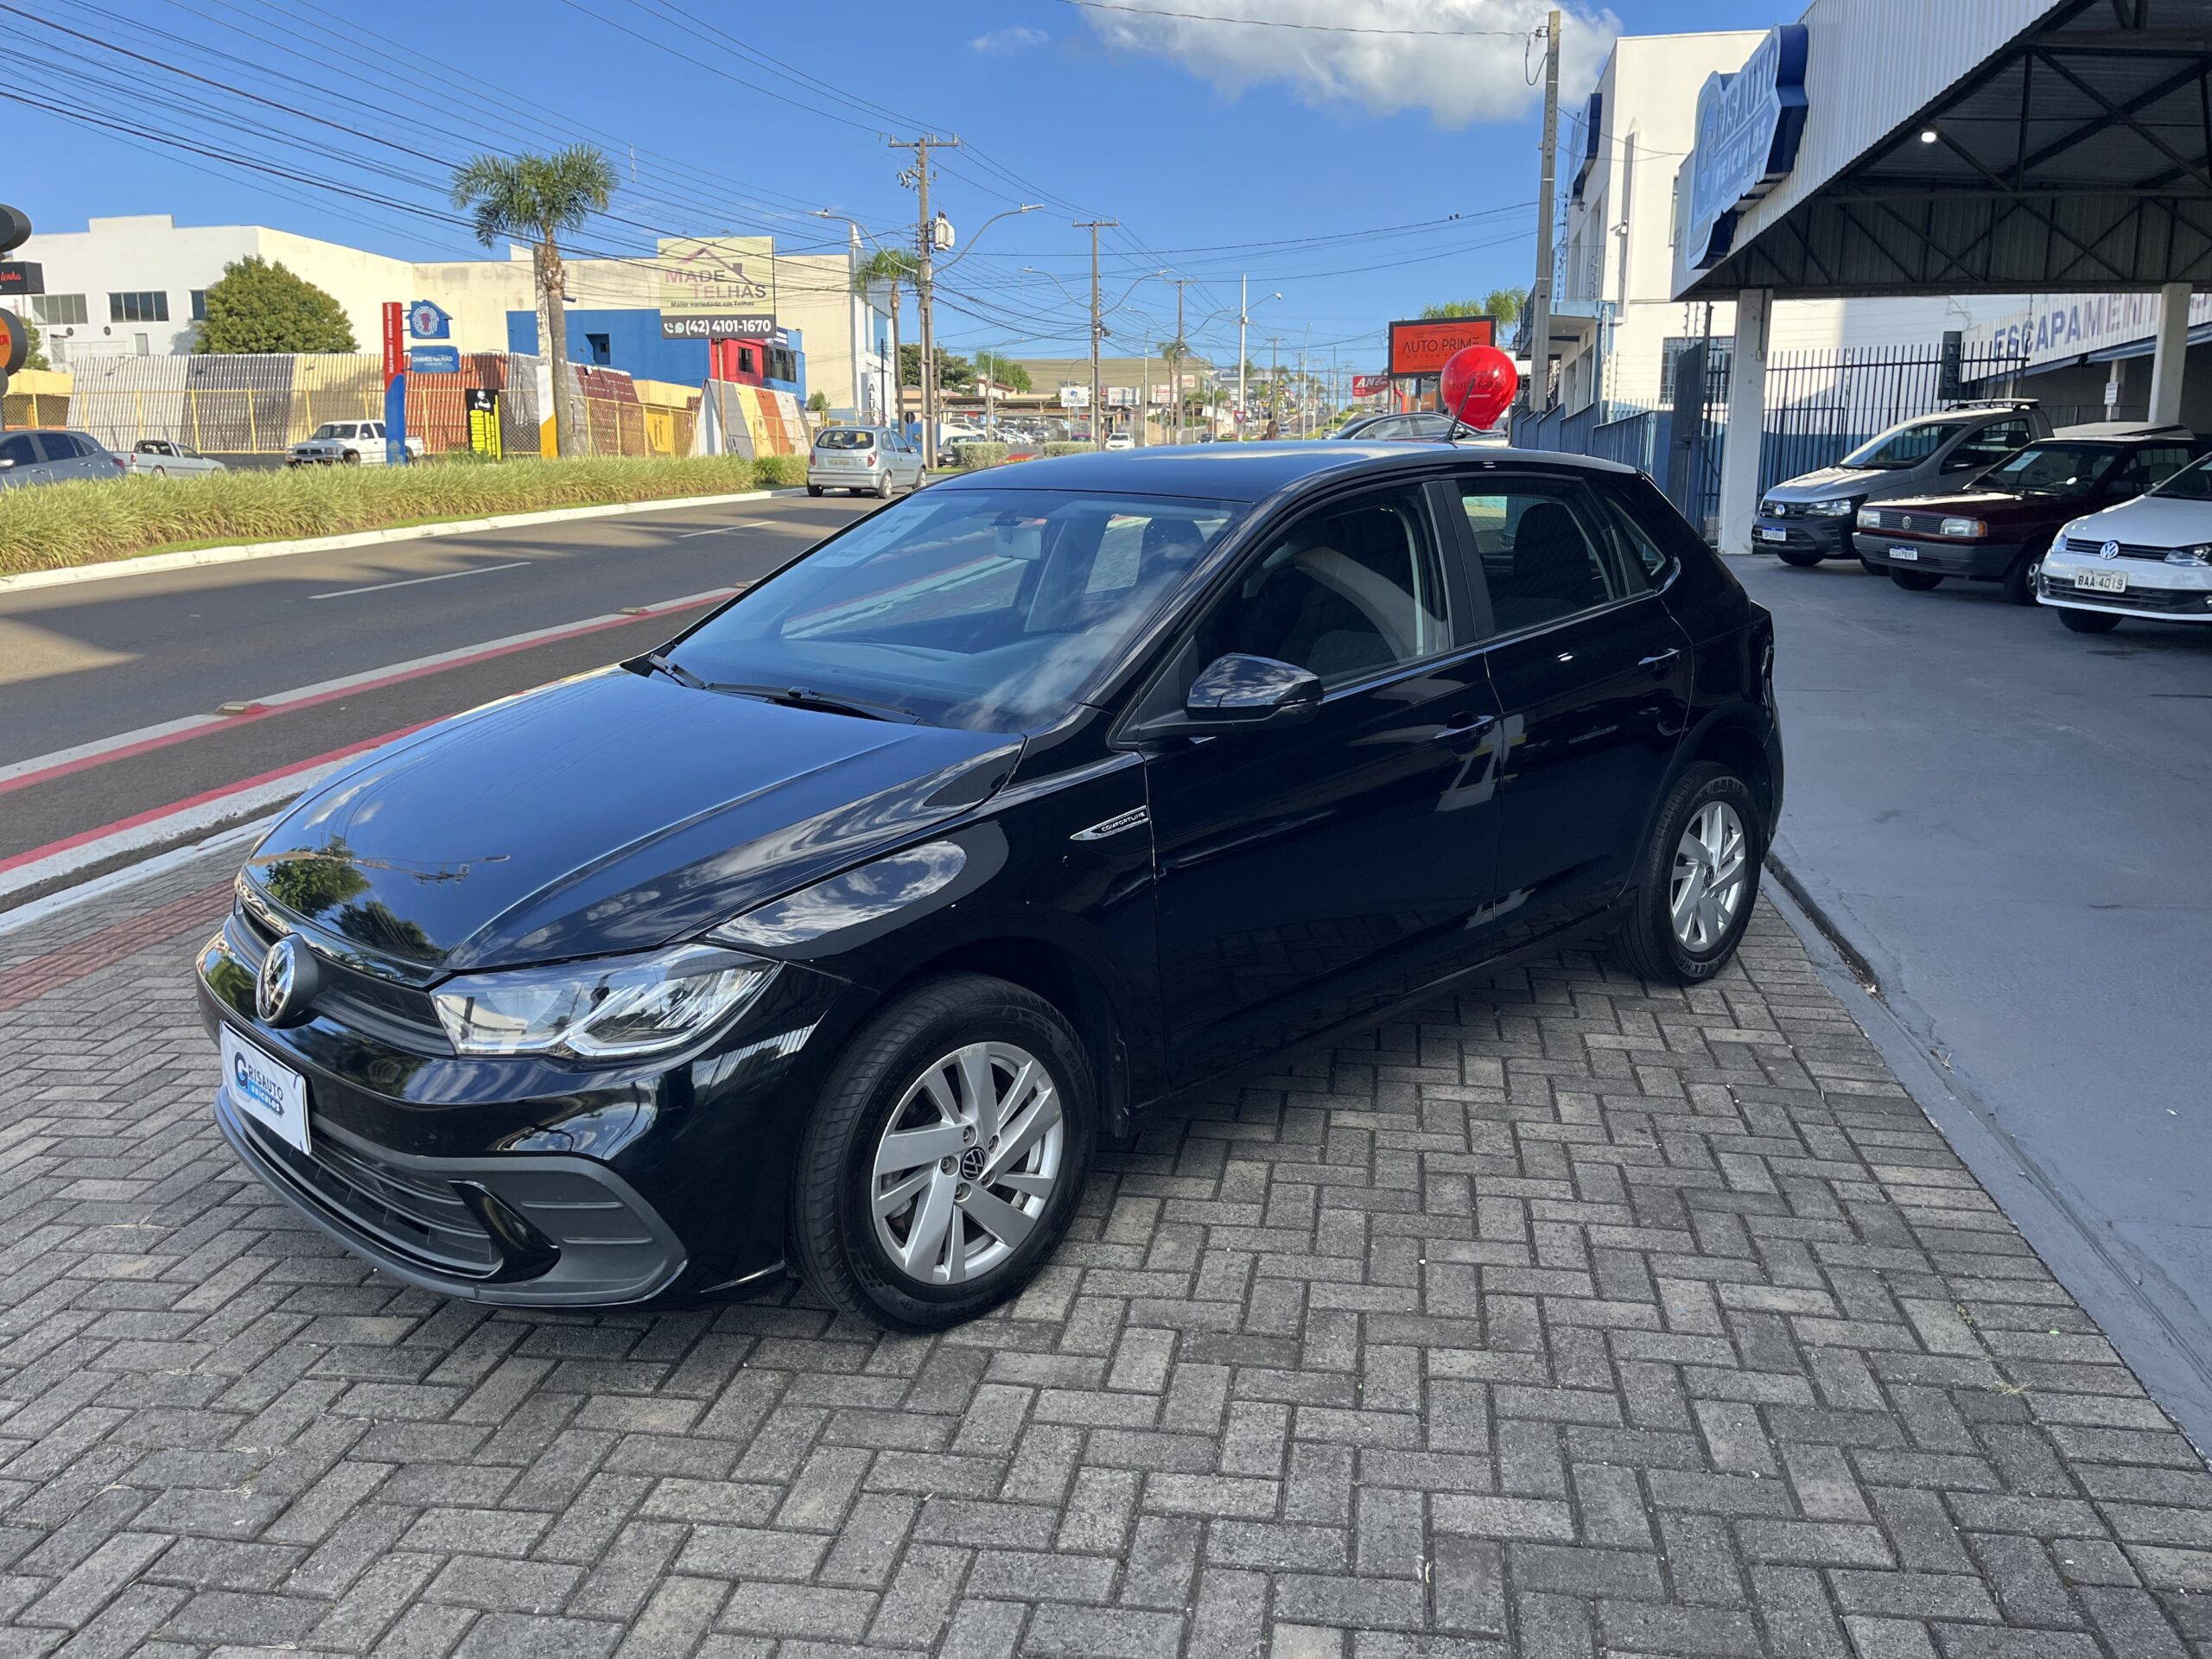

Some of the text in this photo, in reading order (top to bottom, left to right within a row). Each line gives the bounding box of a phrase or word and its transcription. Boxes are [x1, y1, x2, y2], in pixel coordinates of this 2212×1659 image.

[665, 269, 726, 283] MADE
[690, 283, 767, 299] TELHAS
[685, 320, 772, 335] (42) 4101-1670
[1402, 339, 1439, 353] AUTO
[1452, 381, 1475, 391] AUT
[1101, 811, 1146, 832] COMFORTLINE
[234, 1051, 284, 1101] GRISAUTO
[251, 1083, 281, 1113] VEÍCULOS
